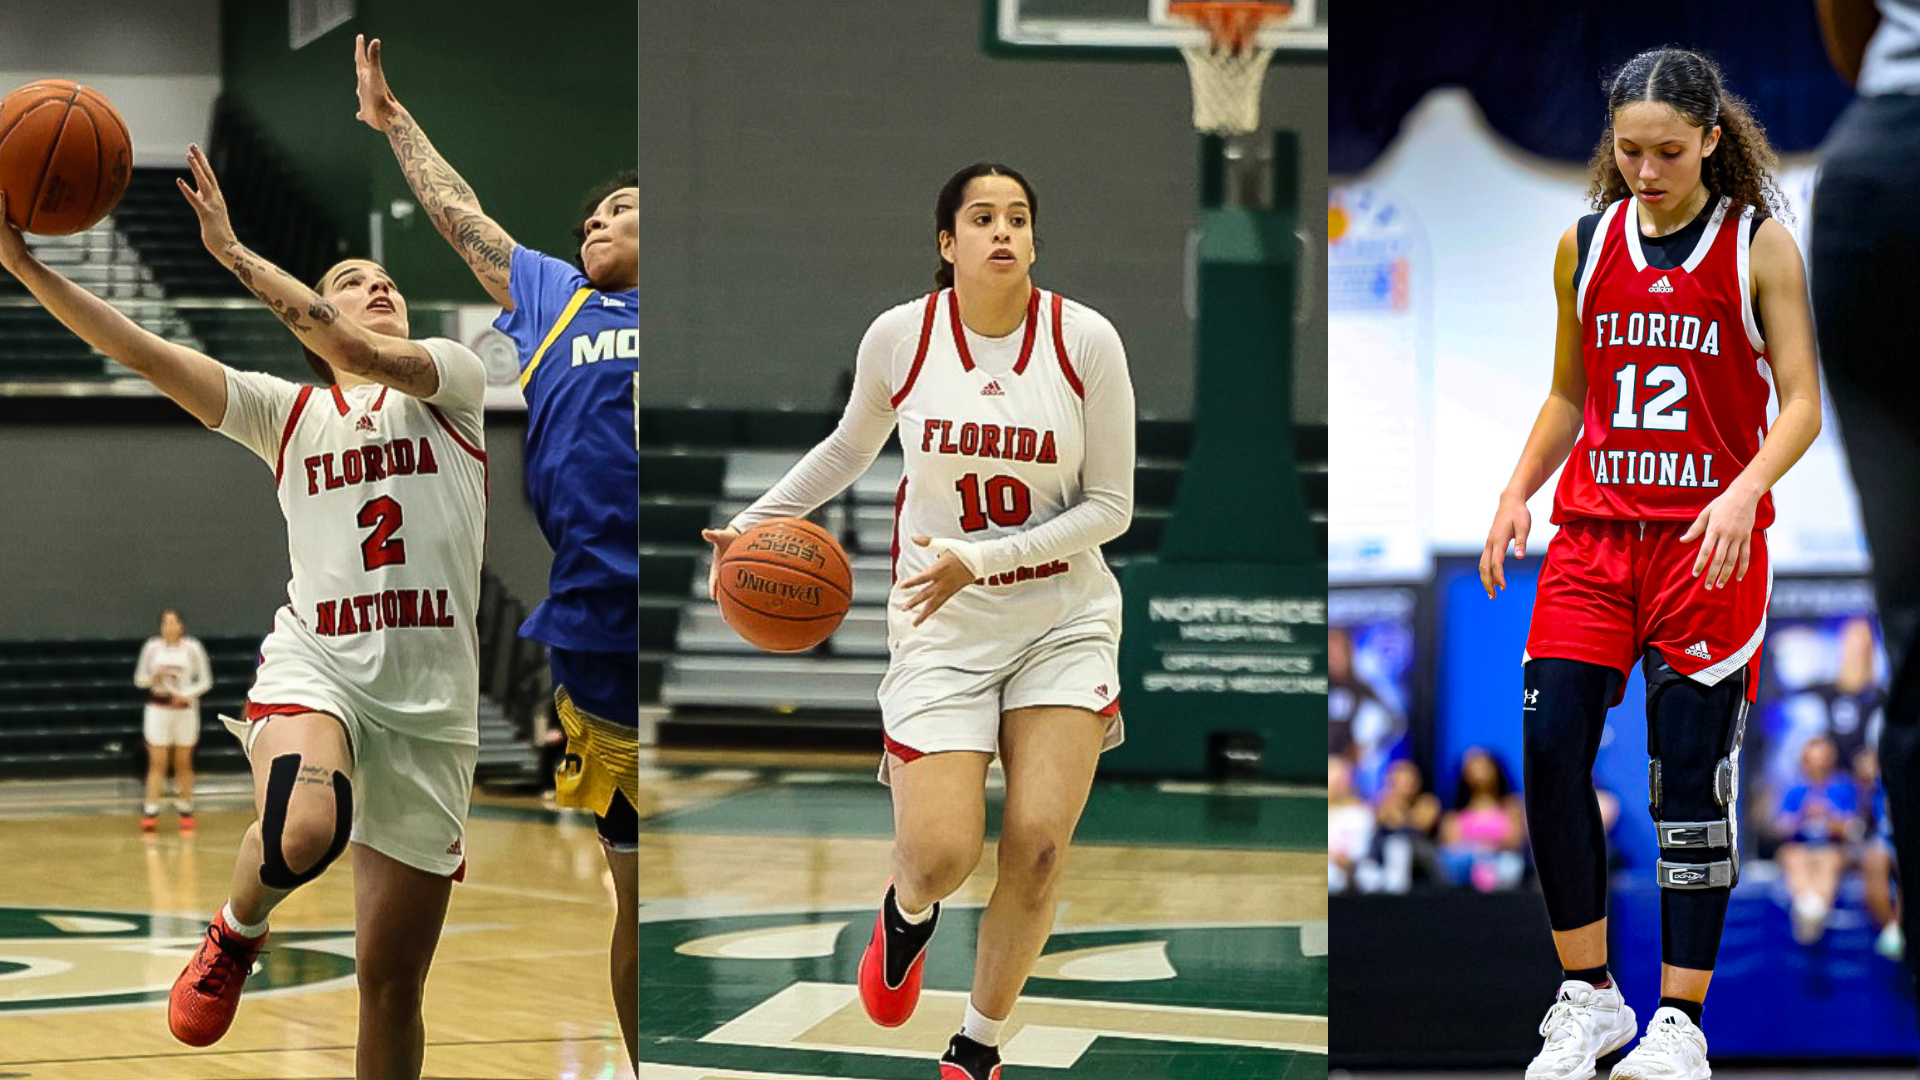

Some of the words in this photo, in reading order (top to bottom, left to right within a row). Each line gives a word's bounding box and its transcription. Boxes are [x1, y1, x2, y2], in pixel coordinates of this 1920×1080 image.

[1595, 311, 1720, 356] FLORIDA
[1610, 362, 1689, 432] 12
[921, 418, 1058, 464] FLORIDA
[304, 436, 438, 496] FLORIDA
[955, 472, 1032, 533] 10
[356, 494, 406, 572] 2
[747, 539, 827, 569] LEGACY
[735, 568, 822, 607] SPALDING
[1149, 597, 1327, 624] NORTHSIDE
[315, 588, 454, 637] NATIONAL
[1684, 647, 1712, 661] adidas
